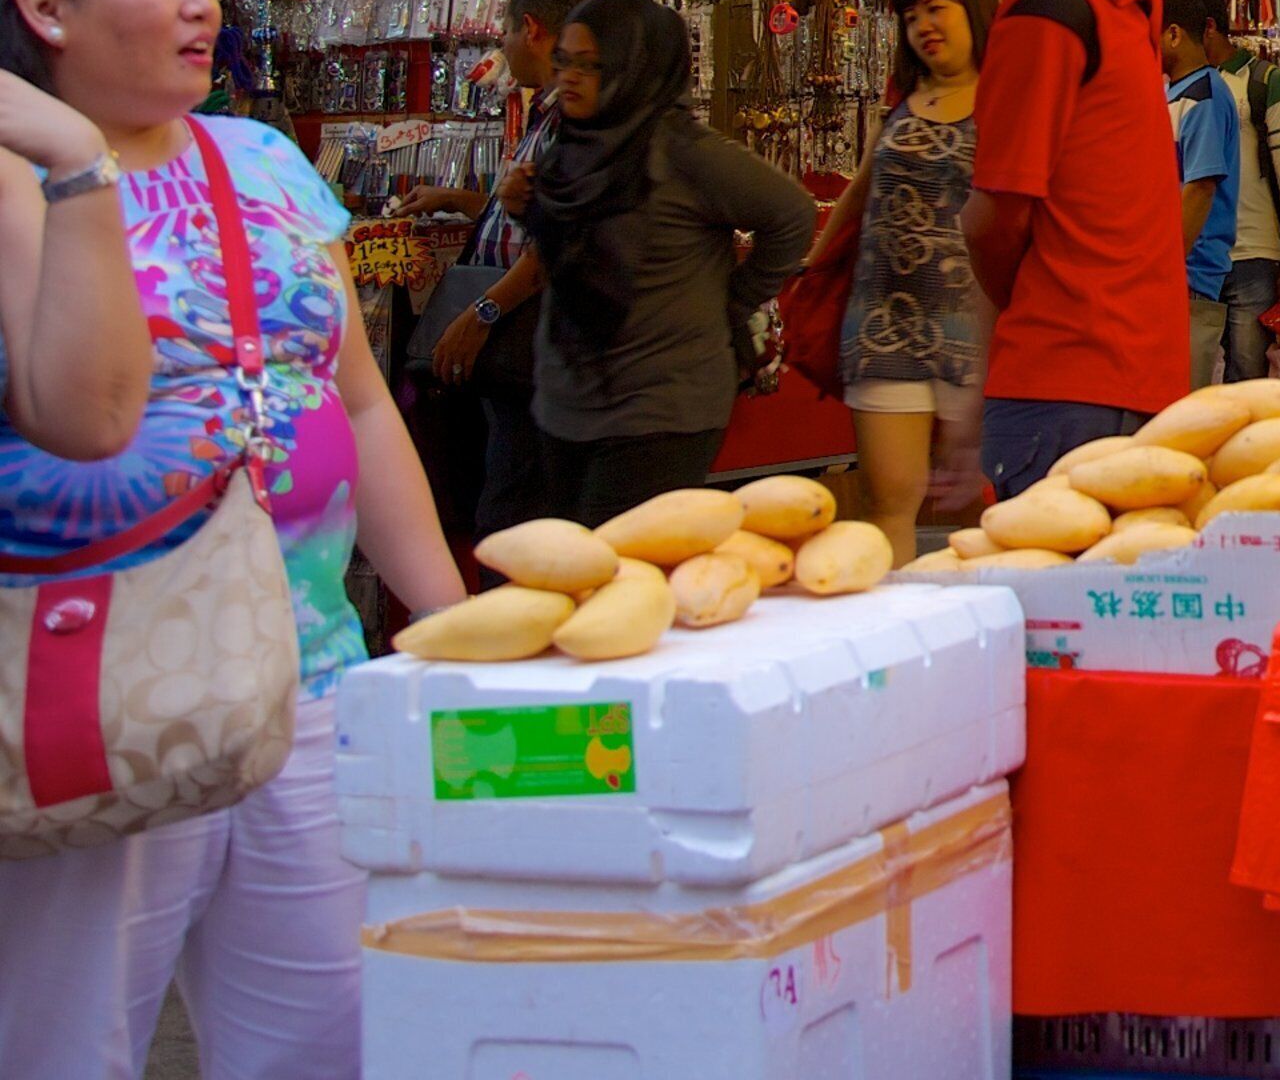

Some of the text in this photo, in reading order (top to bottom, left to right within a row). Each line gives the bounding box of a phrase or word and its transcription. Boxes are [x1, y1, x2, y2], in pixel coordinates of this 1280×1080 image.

[353, 220, 412, 243] SALE
[430, 231, 467, 248] SALE
[359, 244, 368, 260] 1
[391, 238, 412, 258] $1
[358, 262, 374, 275] 12
[391, 260, 414, 278] $10
[1086, 589, 1246, 622] 中国荔枝
